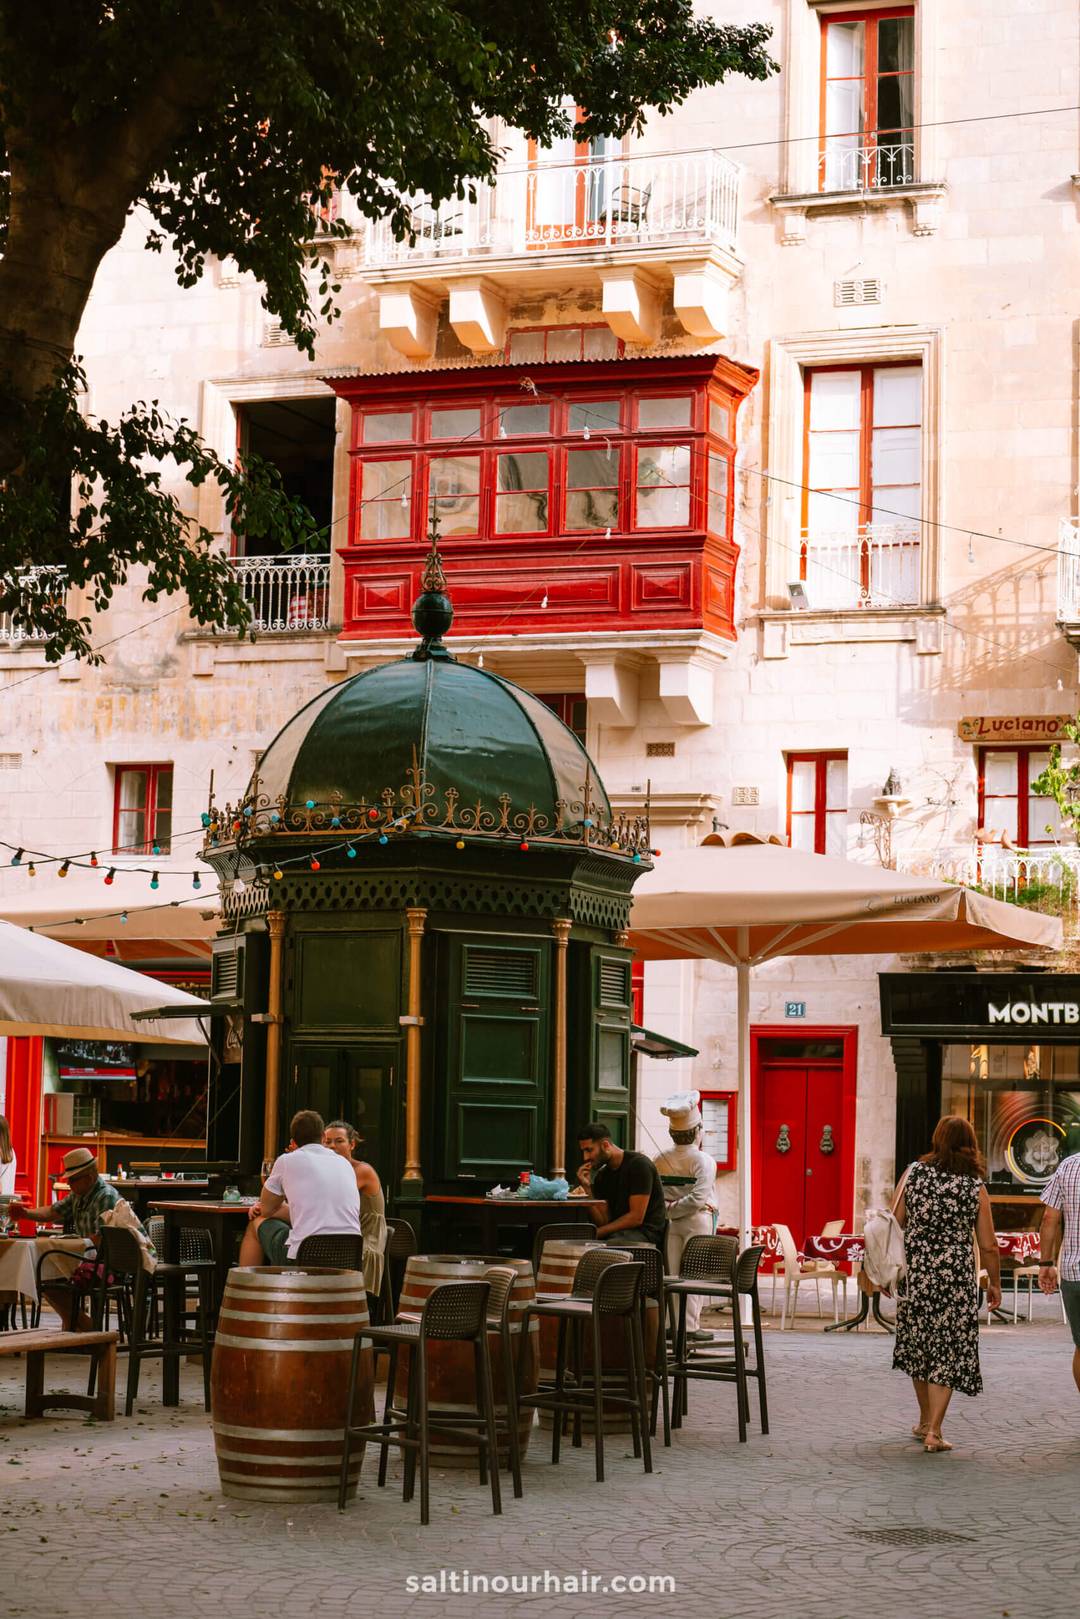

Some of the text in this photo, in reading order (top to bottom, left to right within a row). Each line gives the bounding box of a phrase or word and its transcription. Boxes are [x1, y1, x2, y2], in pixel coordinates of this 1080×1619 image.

[978, 717, 1059, 735] Luciano
[894, 895, 940, 904] LUCIANO
[789, 1004, 801, 1015] 21
[988, 1002, 1080, 1024] MONTB
